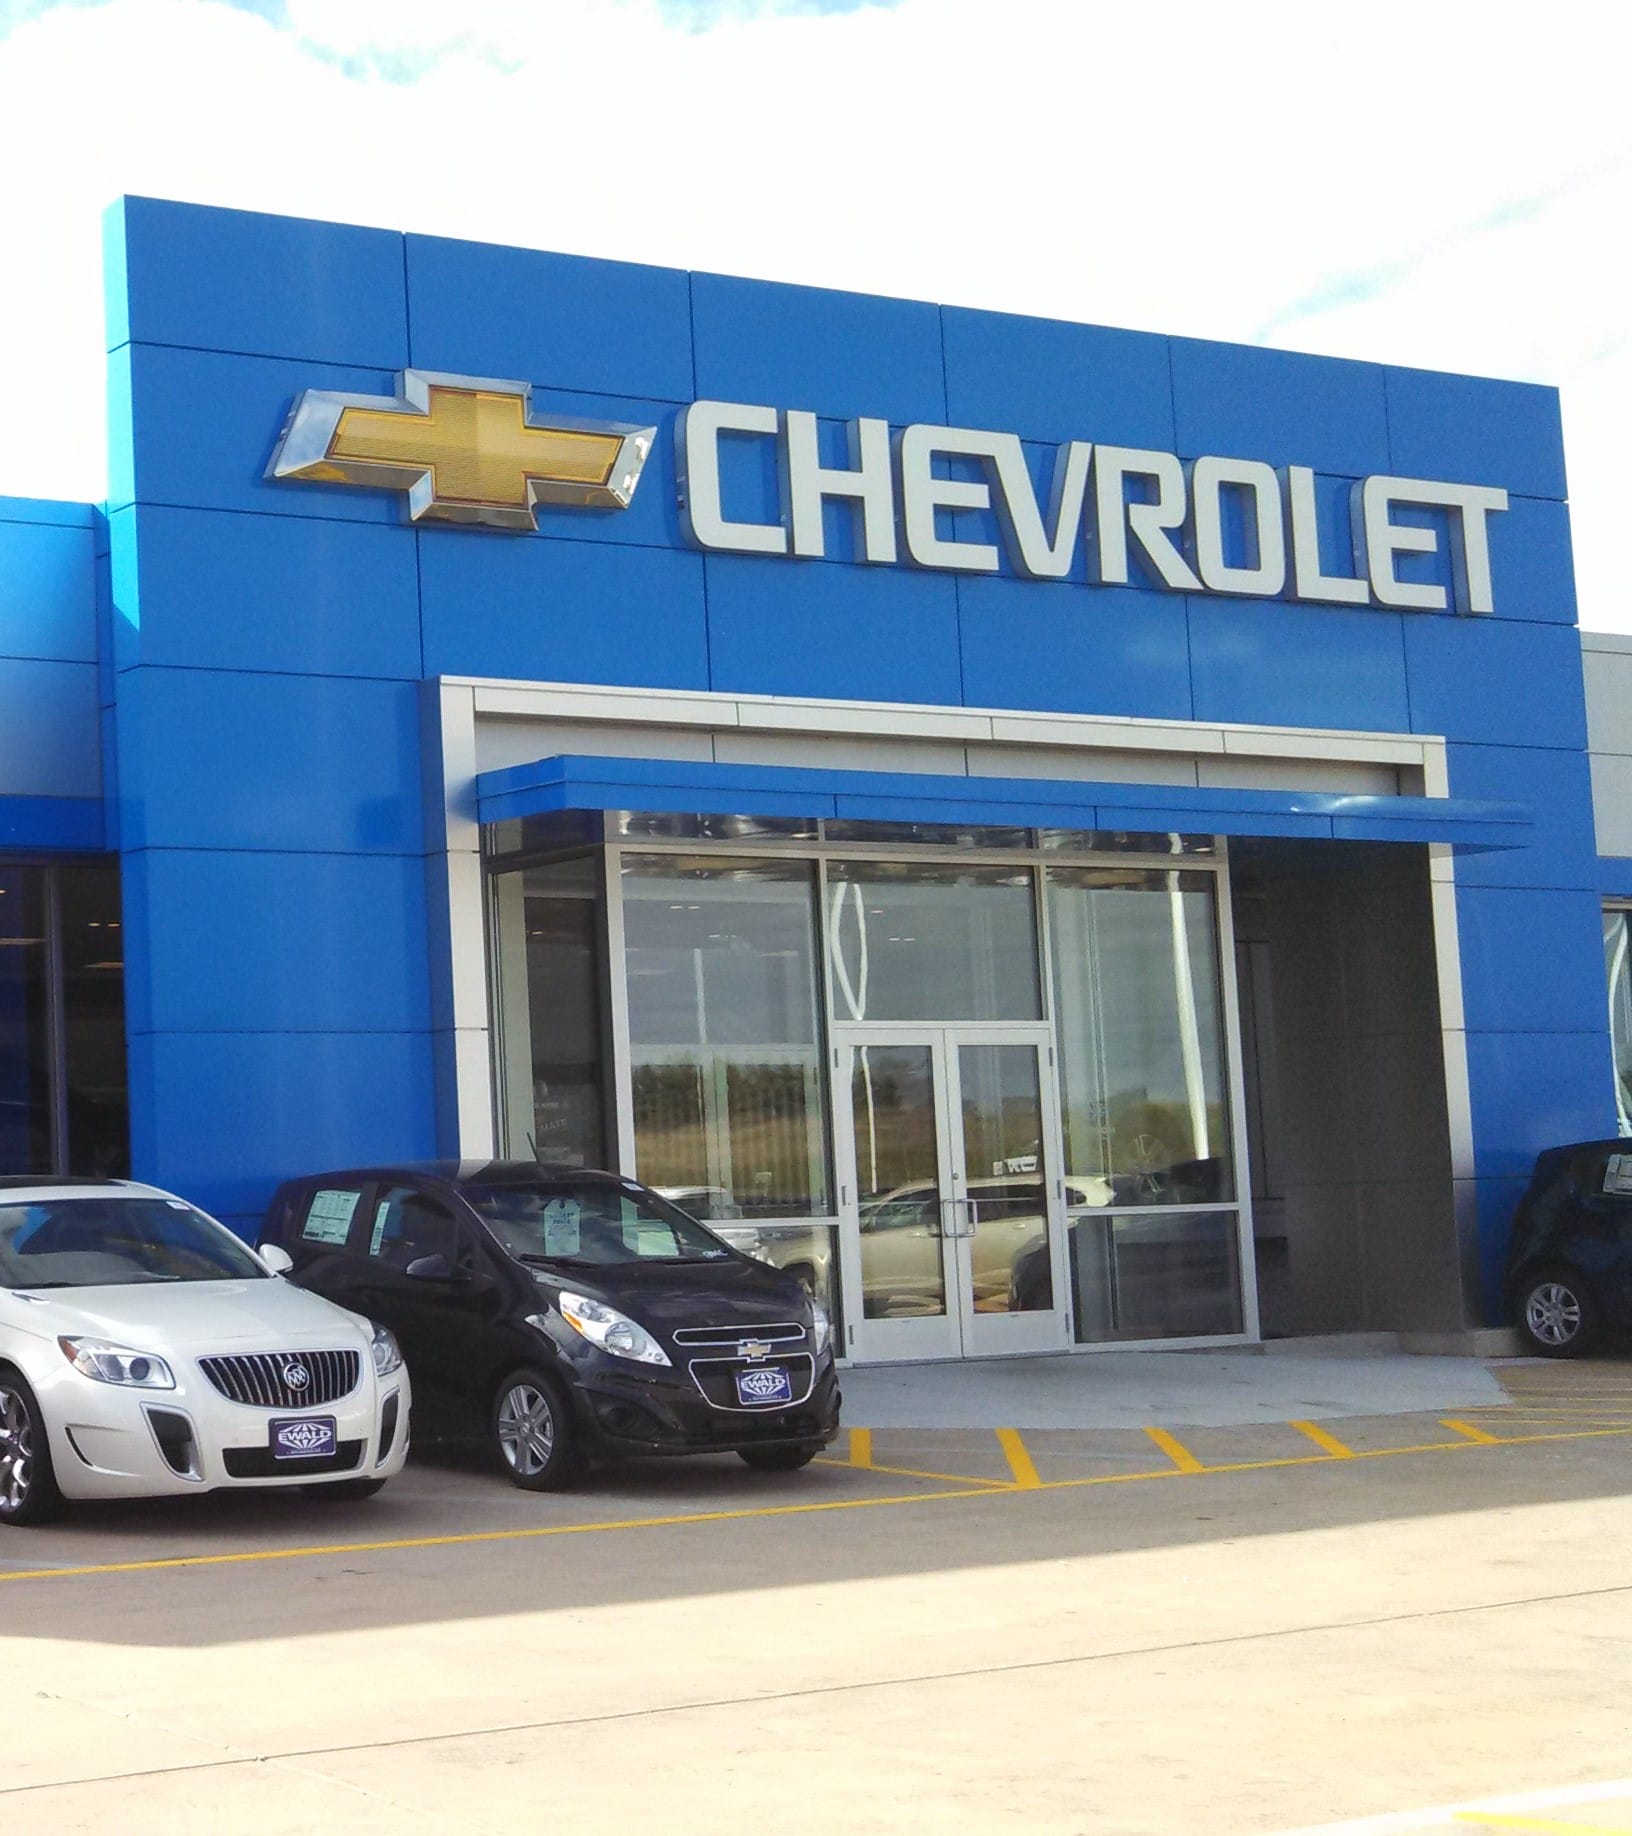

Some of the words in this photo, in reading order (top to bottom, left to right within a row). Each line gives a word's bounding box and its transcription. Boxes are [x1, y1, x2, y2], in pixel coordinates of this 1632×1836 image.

[674, 399, 1509, 613] CHEVROLET
[741, 1378, 786, 1390] EWALD
[278, 1430, 332, 1441] EWALD
